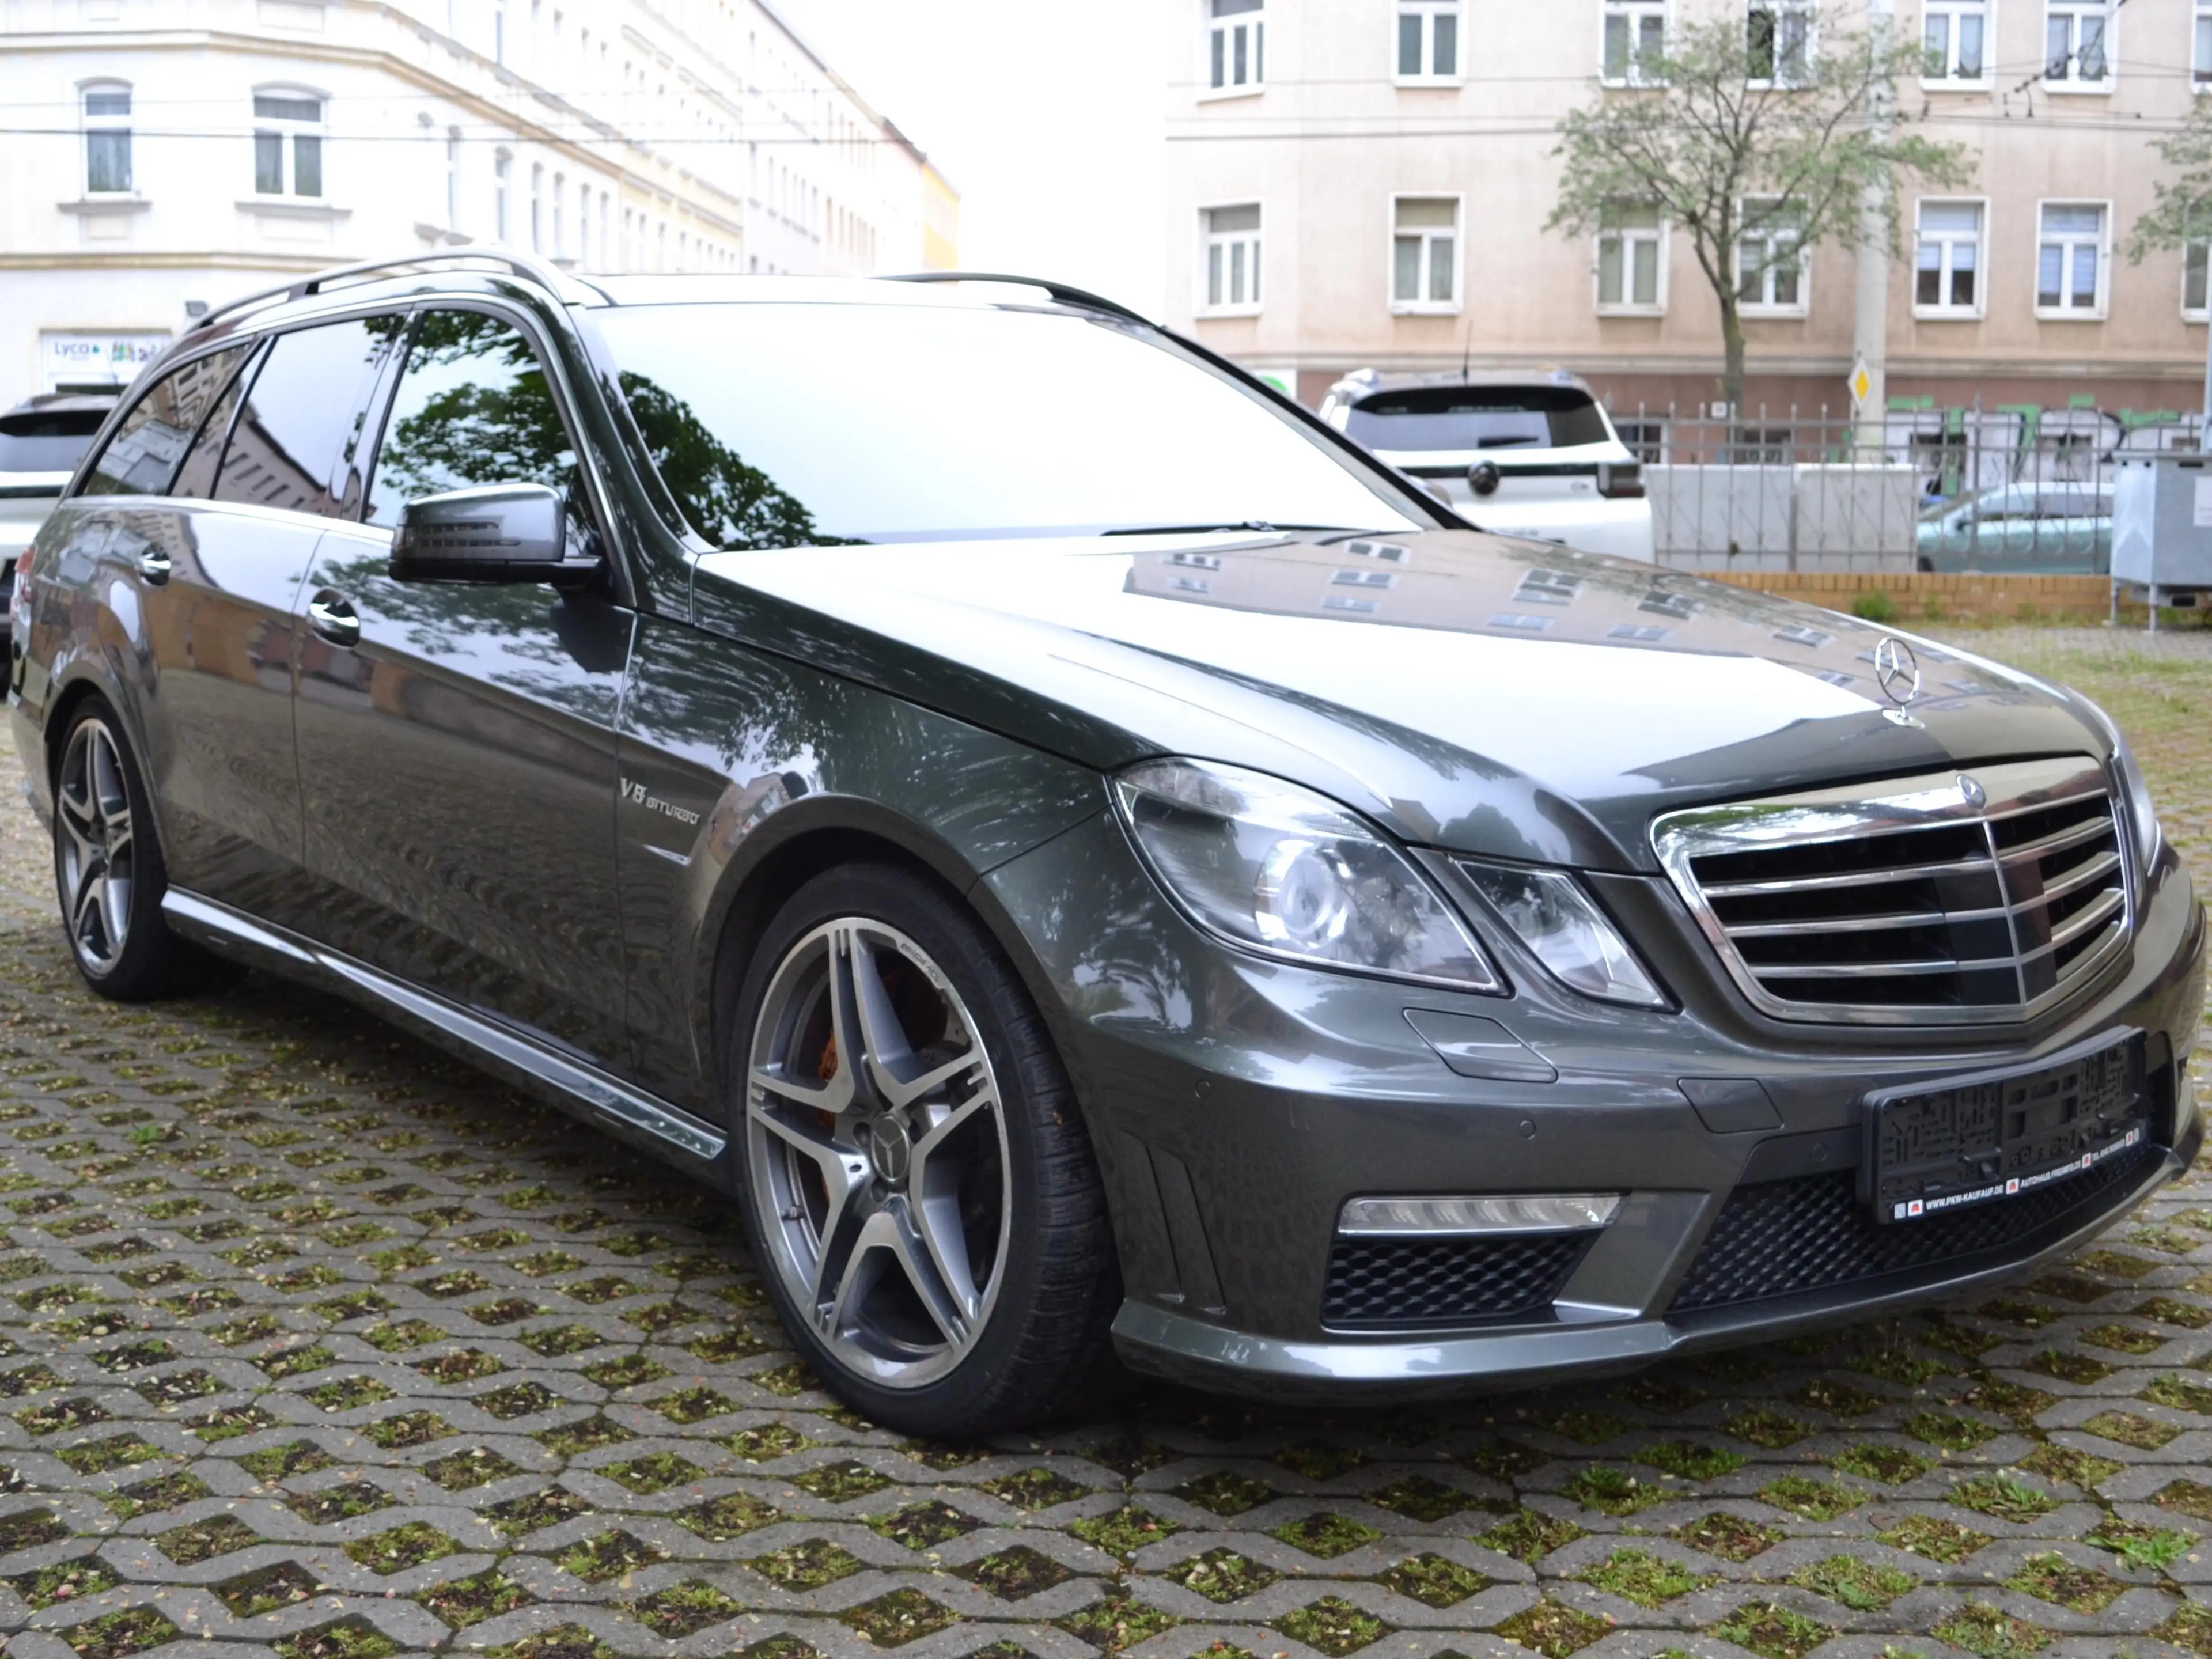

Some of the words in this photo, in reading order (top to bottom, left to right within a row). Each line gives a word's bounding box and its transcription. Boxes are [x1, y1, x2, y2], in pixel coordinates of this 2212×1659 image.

[54, 342, 90, 358] Lyca
[620, 777, 647, 804] V8
[646, 796, 700, 825] BITURBO
[2020, 1171, 2050, 1188] AUTOHAUS
